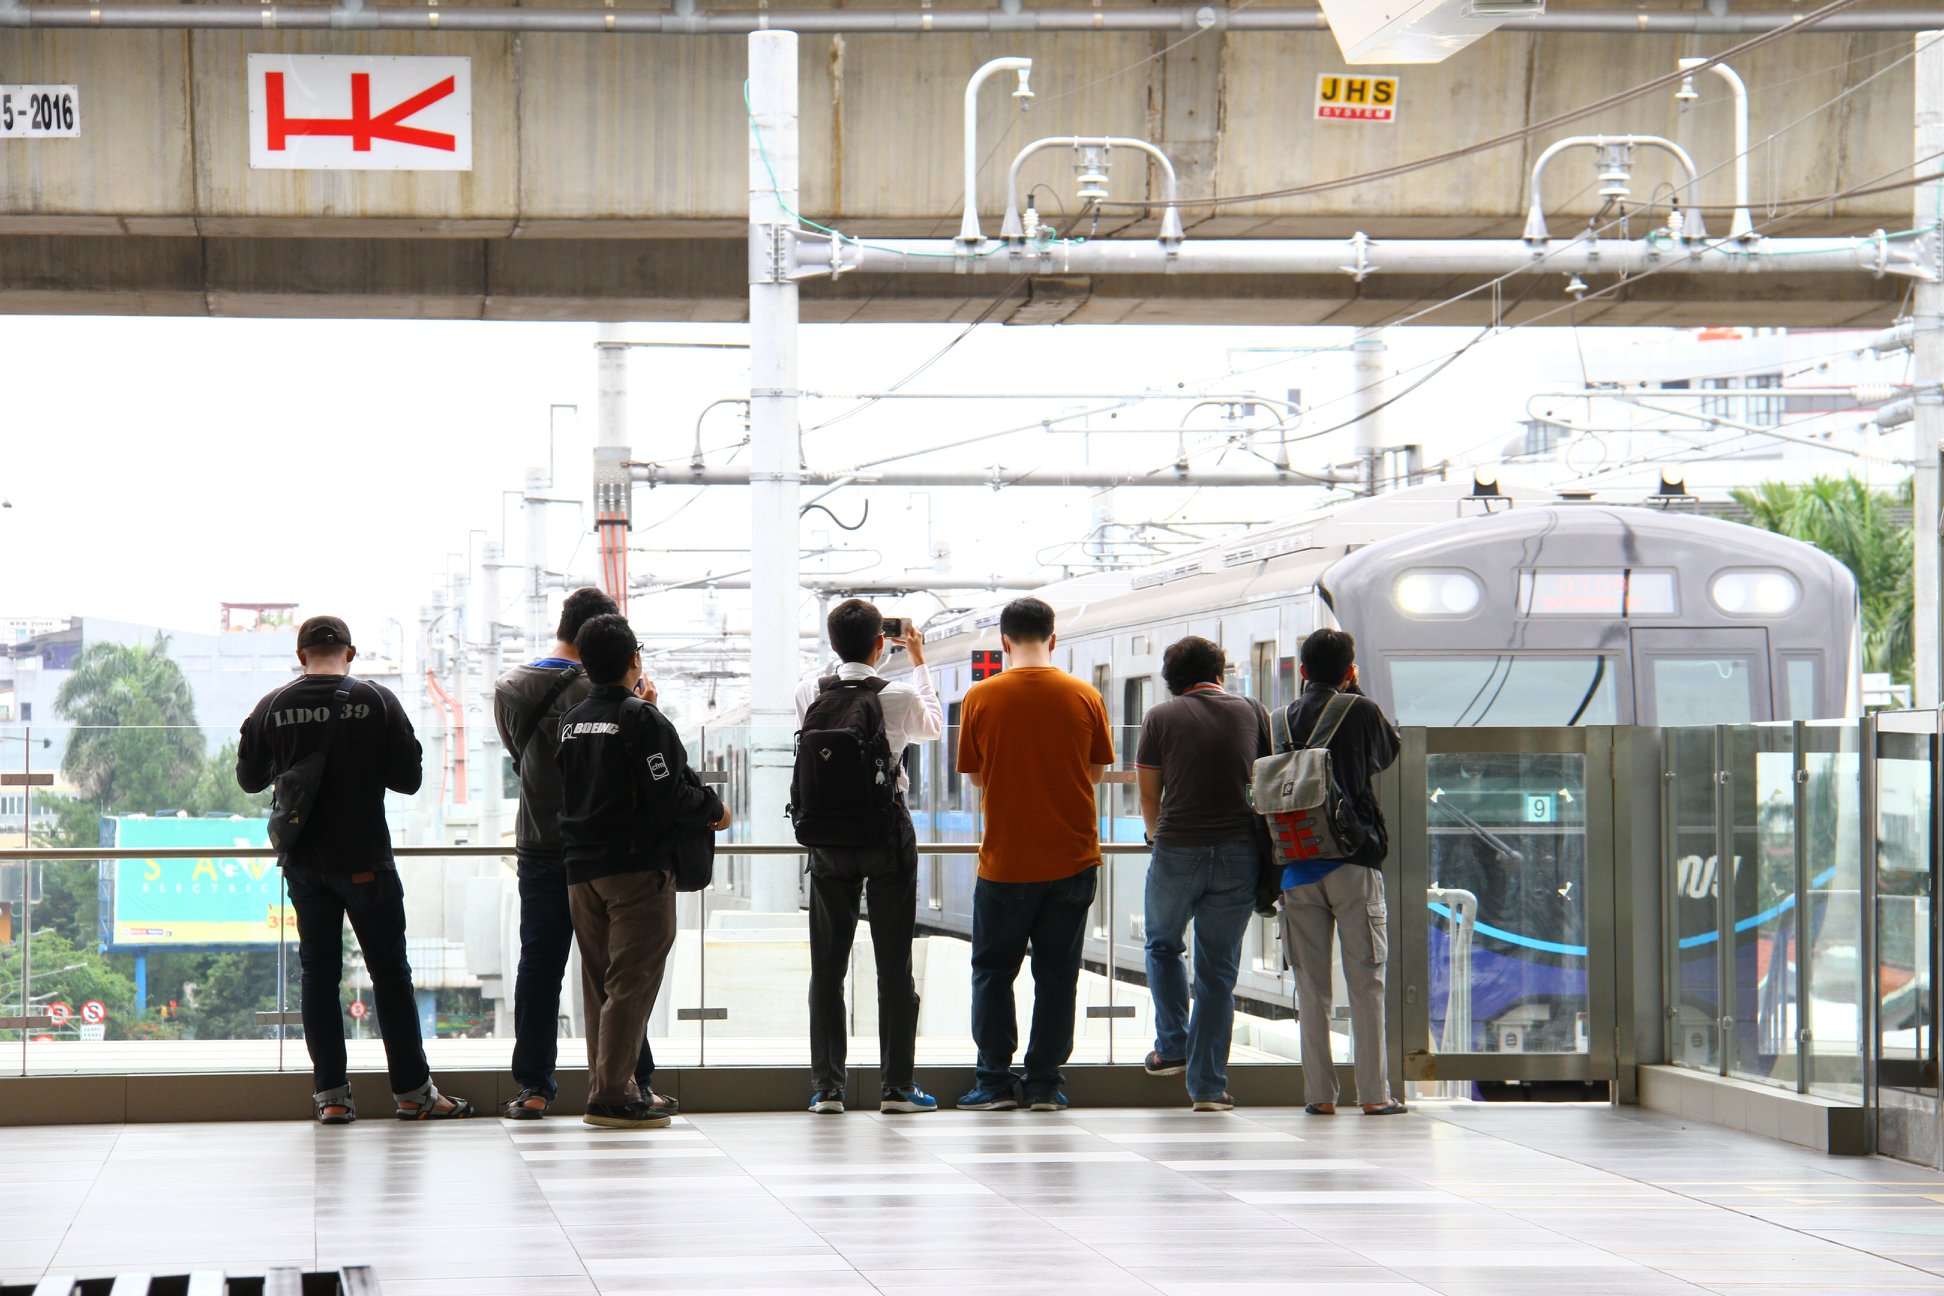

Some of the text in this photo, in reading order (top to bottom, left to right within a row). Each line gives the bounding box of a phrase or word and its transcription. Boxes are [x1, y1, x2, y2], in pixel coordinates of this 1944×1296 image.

[1322, 78, 1392, 103] JHS
[272, 703, 370, 727] LIDO 39
[573, 722, 620, 734] BOEING
[1534, 799, 1545, 818] 9
